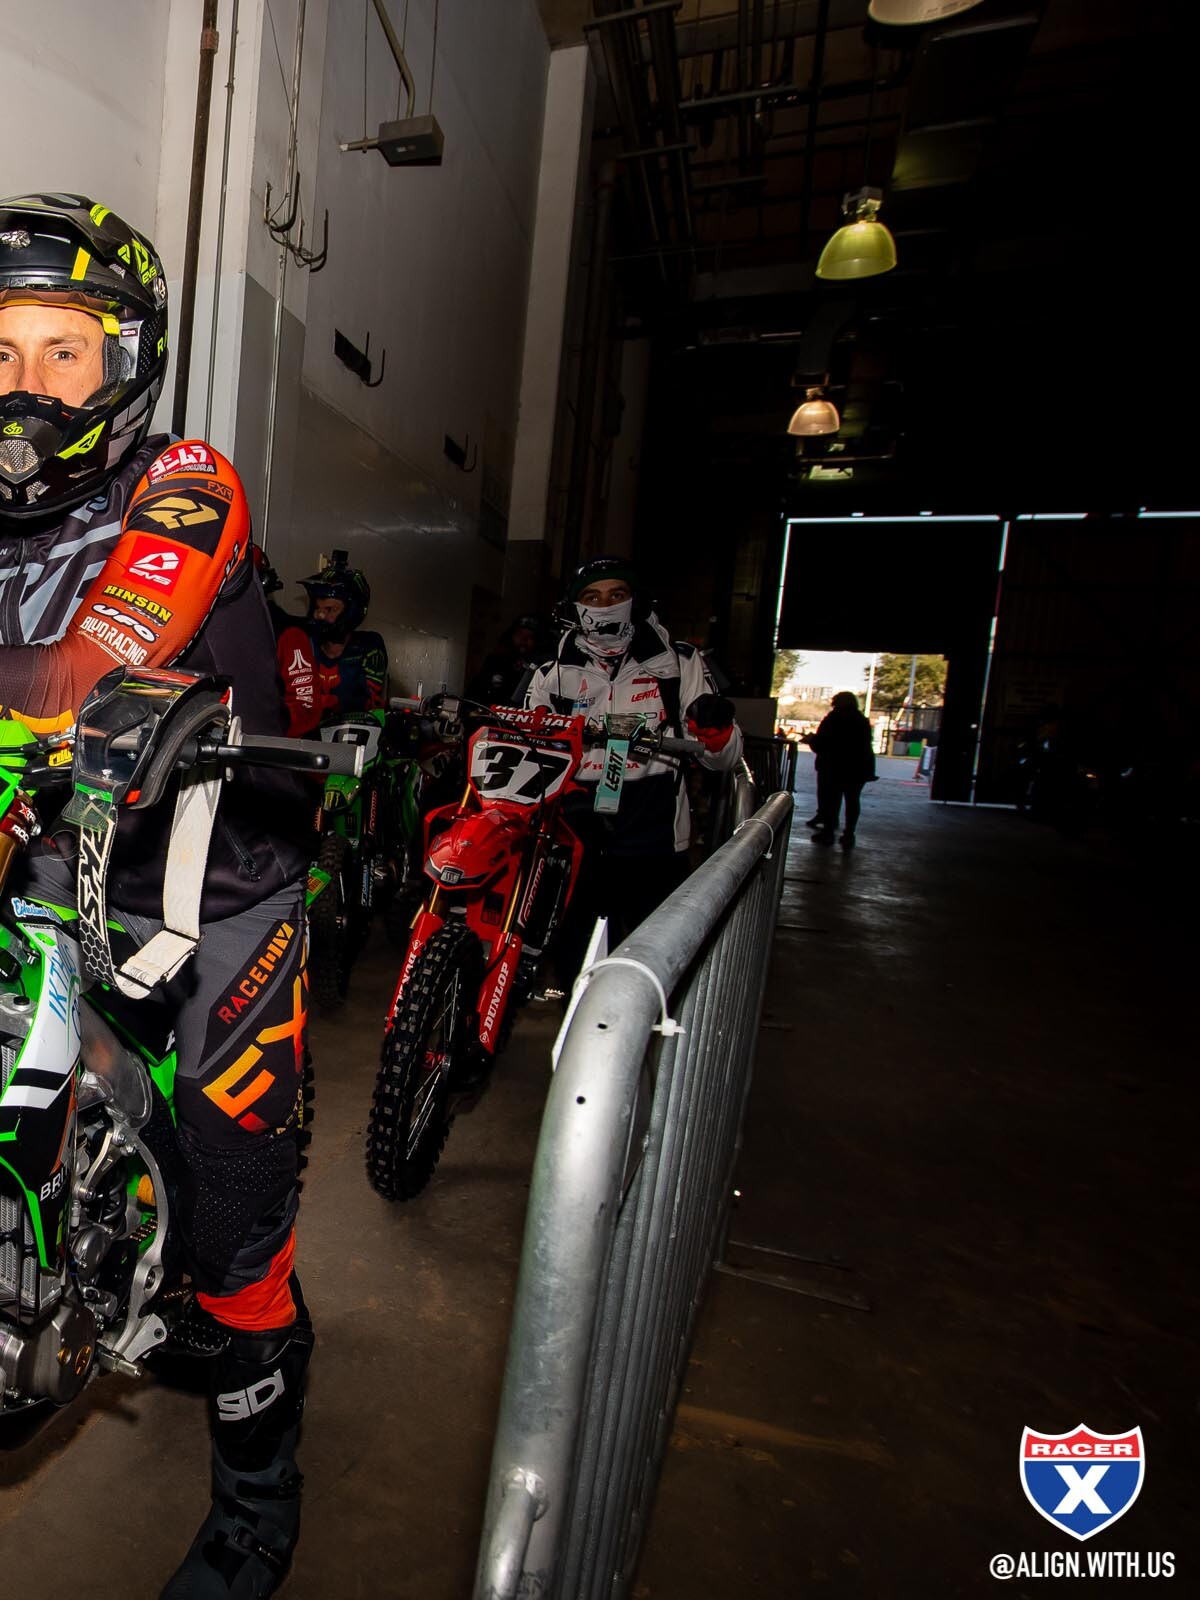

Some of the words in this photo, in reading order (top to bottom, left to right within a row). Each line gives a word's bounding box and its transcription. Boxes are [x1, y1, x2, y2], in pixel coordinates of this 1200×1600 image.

[207, 480, 234, 500] FXR
[104, 585, 173, 622] HINSON
[92, 604, 156, 642] UFO
[473, 745, 570, 800] 37
[485, 961, 510, 1031] DUNLOP
